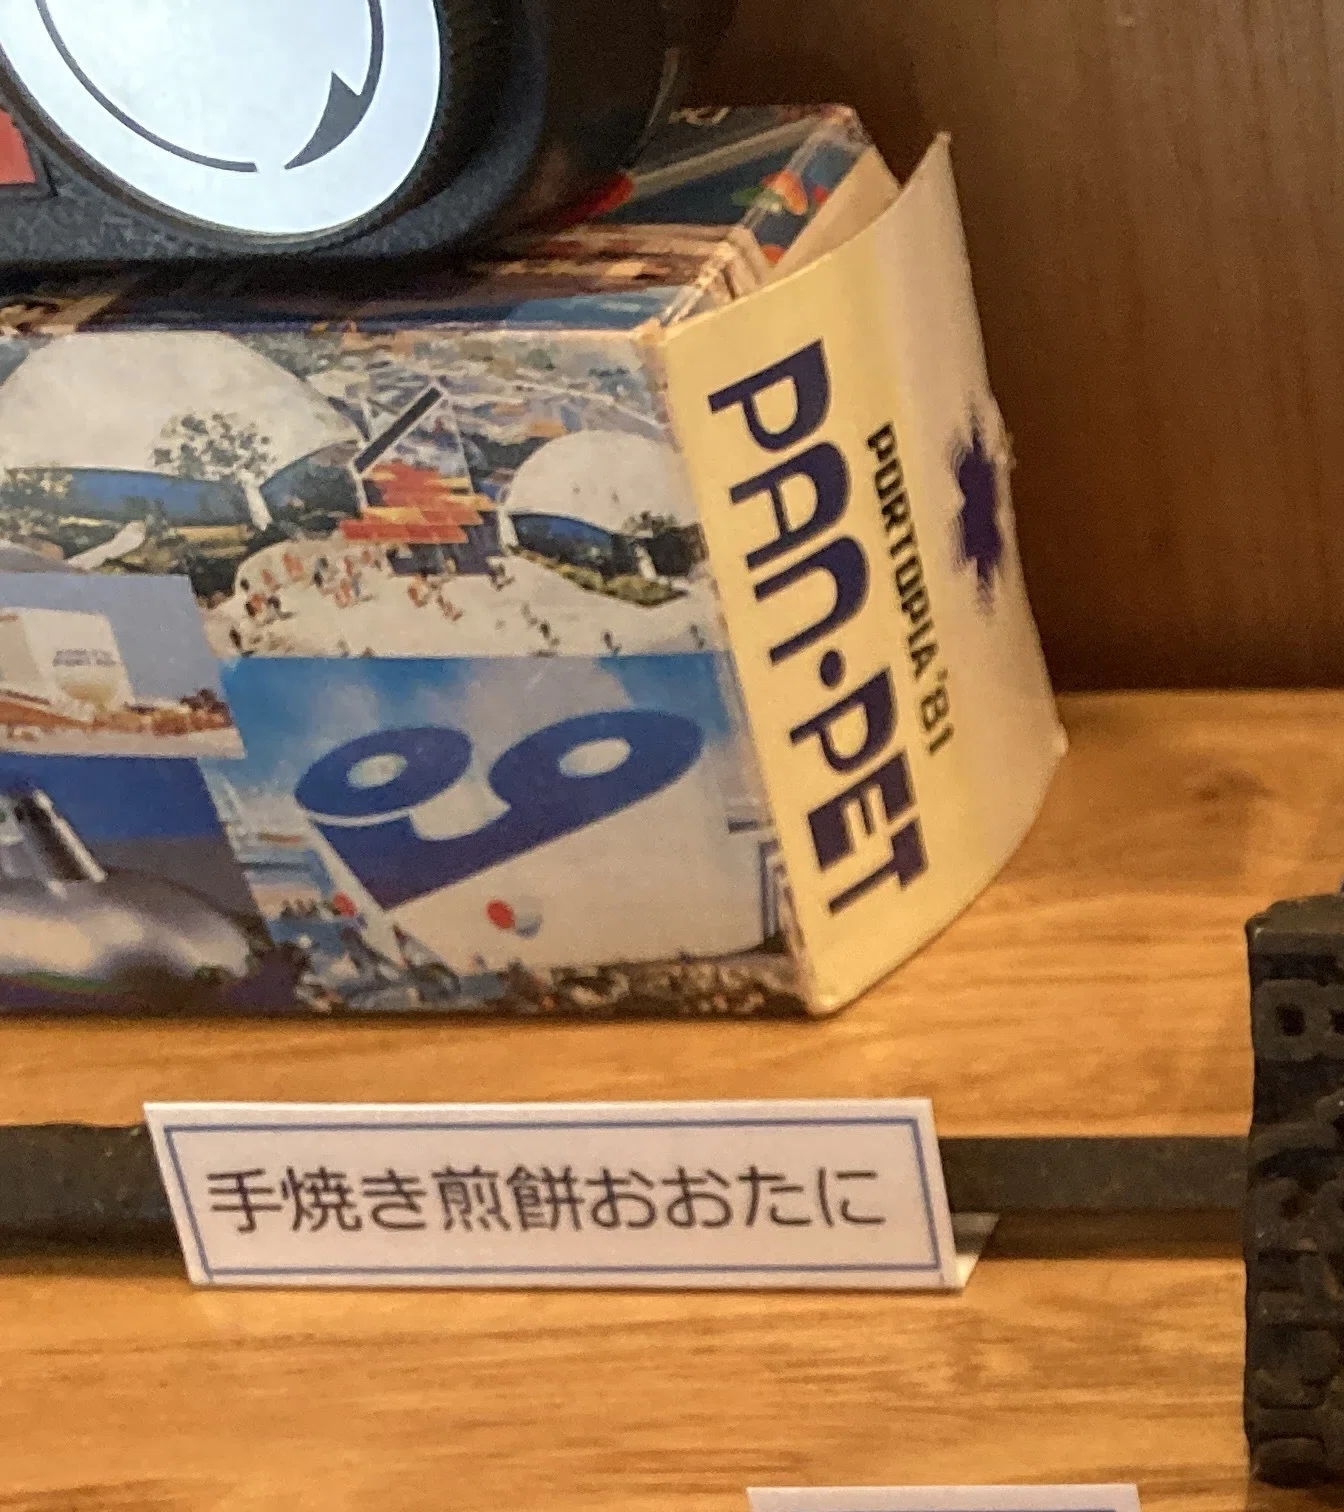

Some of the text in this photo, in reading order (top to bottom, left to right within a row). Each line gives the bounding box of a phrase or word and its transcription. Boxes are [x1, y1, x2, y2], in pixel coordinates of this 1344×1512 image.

[866, 421, 937, 678] PORTOPIA
[205, 1165, 887, 1233] 手焼き煎餅おおたに
